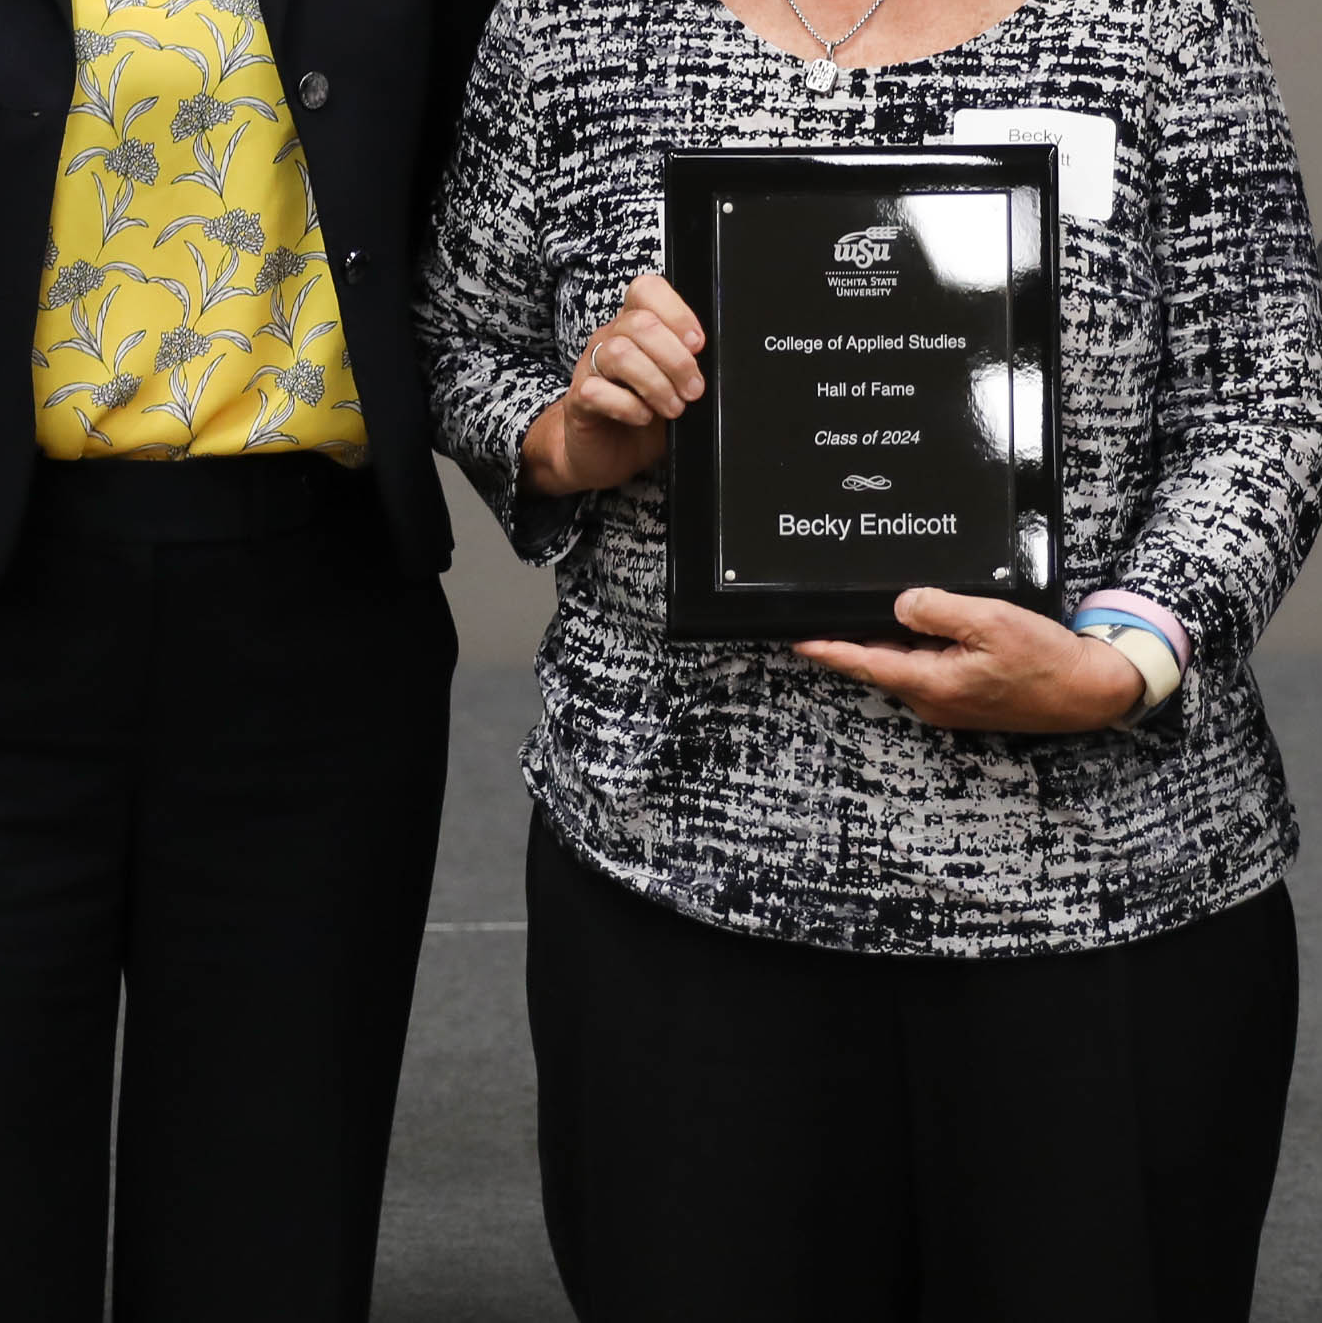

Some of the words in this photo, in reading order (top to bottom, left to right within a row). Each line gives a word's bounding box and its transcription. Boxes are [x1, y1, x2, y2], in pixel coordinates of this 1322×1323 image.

[1008, 128, 1063, 146] Becky
[827, 276, 867, 287] WICHITA
[870, 276, 897, 287] STATE
[836, 287, 892, 296] UNIVERSITY
[764, 335, 823, 353] College
[827, 335, 844, 350] of
[846, 335, 904, 353] Applied
[908, 334, 966, 350] Studies
[817, 382, 847, 397] Hall
[851, 382, 866, 397] of
[871, 383, 915, 397] Fame
[814, 430, 857, 446] Class
[861, 430, 878, 446] of
[880, 430, 920, 446] 2024
[778, 514, 851, 541] Becky
[860, 513, 957, 536] Endicott
